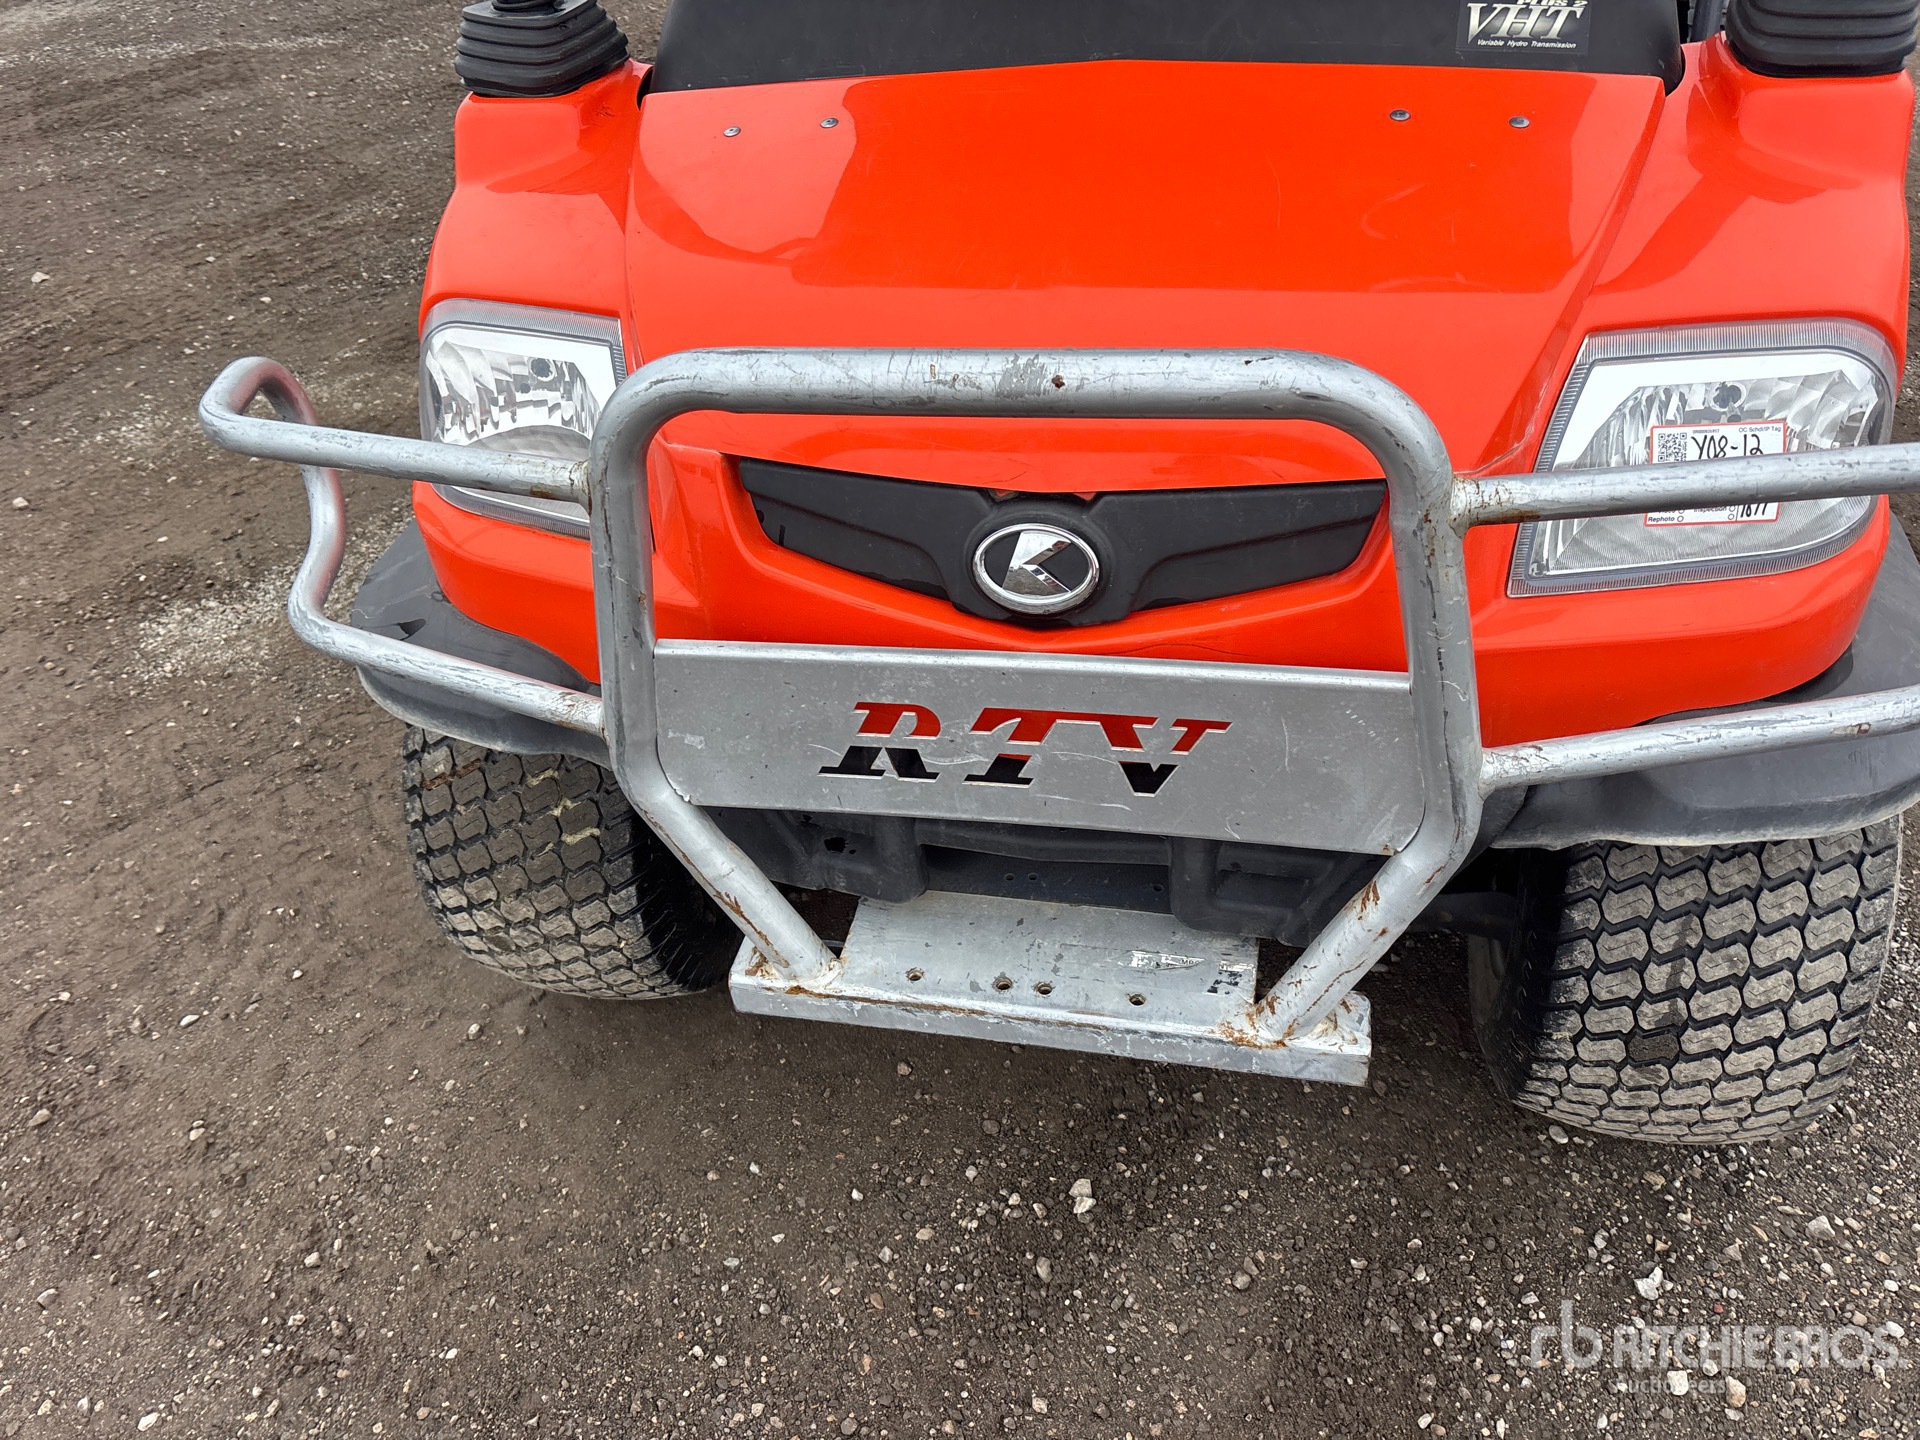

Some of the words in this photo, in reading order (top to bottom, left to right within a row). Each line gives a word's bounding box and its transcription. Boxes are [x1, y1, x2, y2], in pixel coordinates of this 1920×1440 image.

[1466, 3, 1586, 44] VHT
[1477, 39, 1505, 47] Variable
[1506, 40, 1528, 48] Hydro
[1531, 40, 1577, 49] Transmission
[1690, 433, 1764, 460] Y08-12
[817, 701, 1233, 798] RTV
